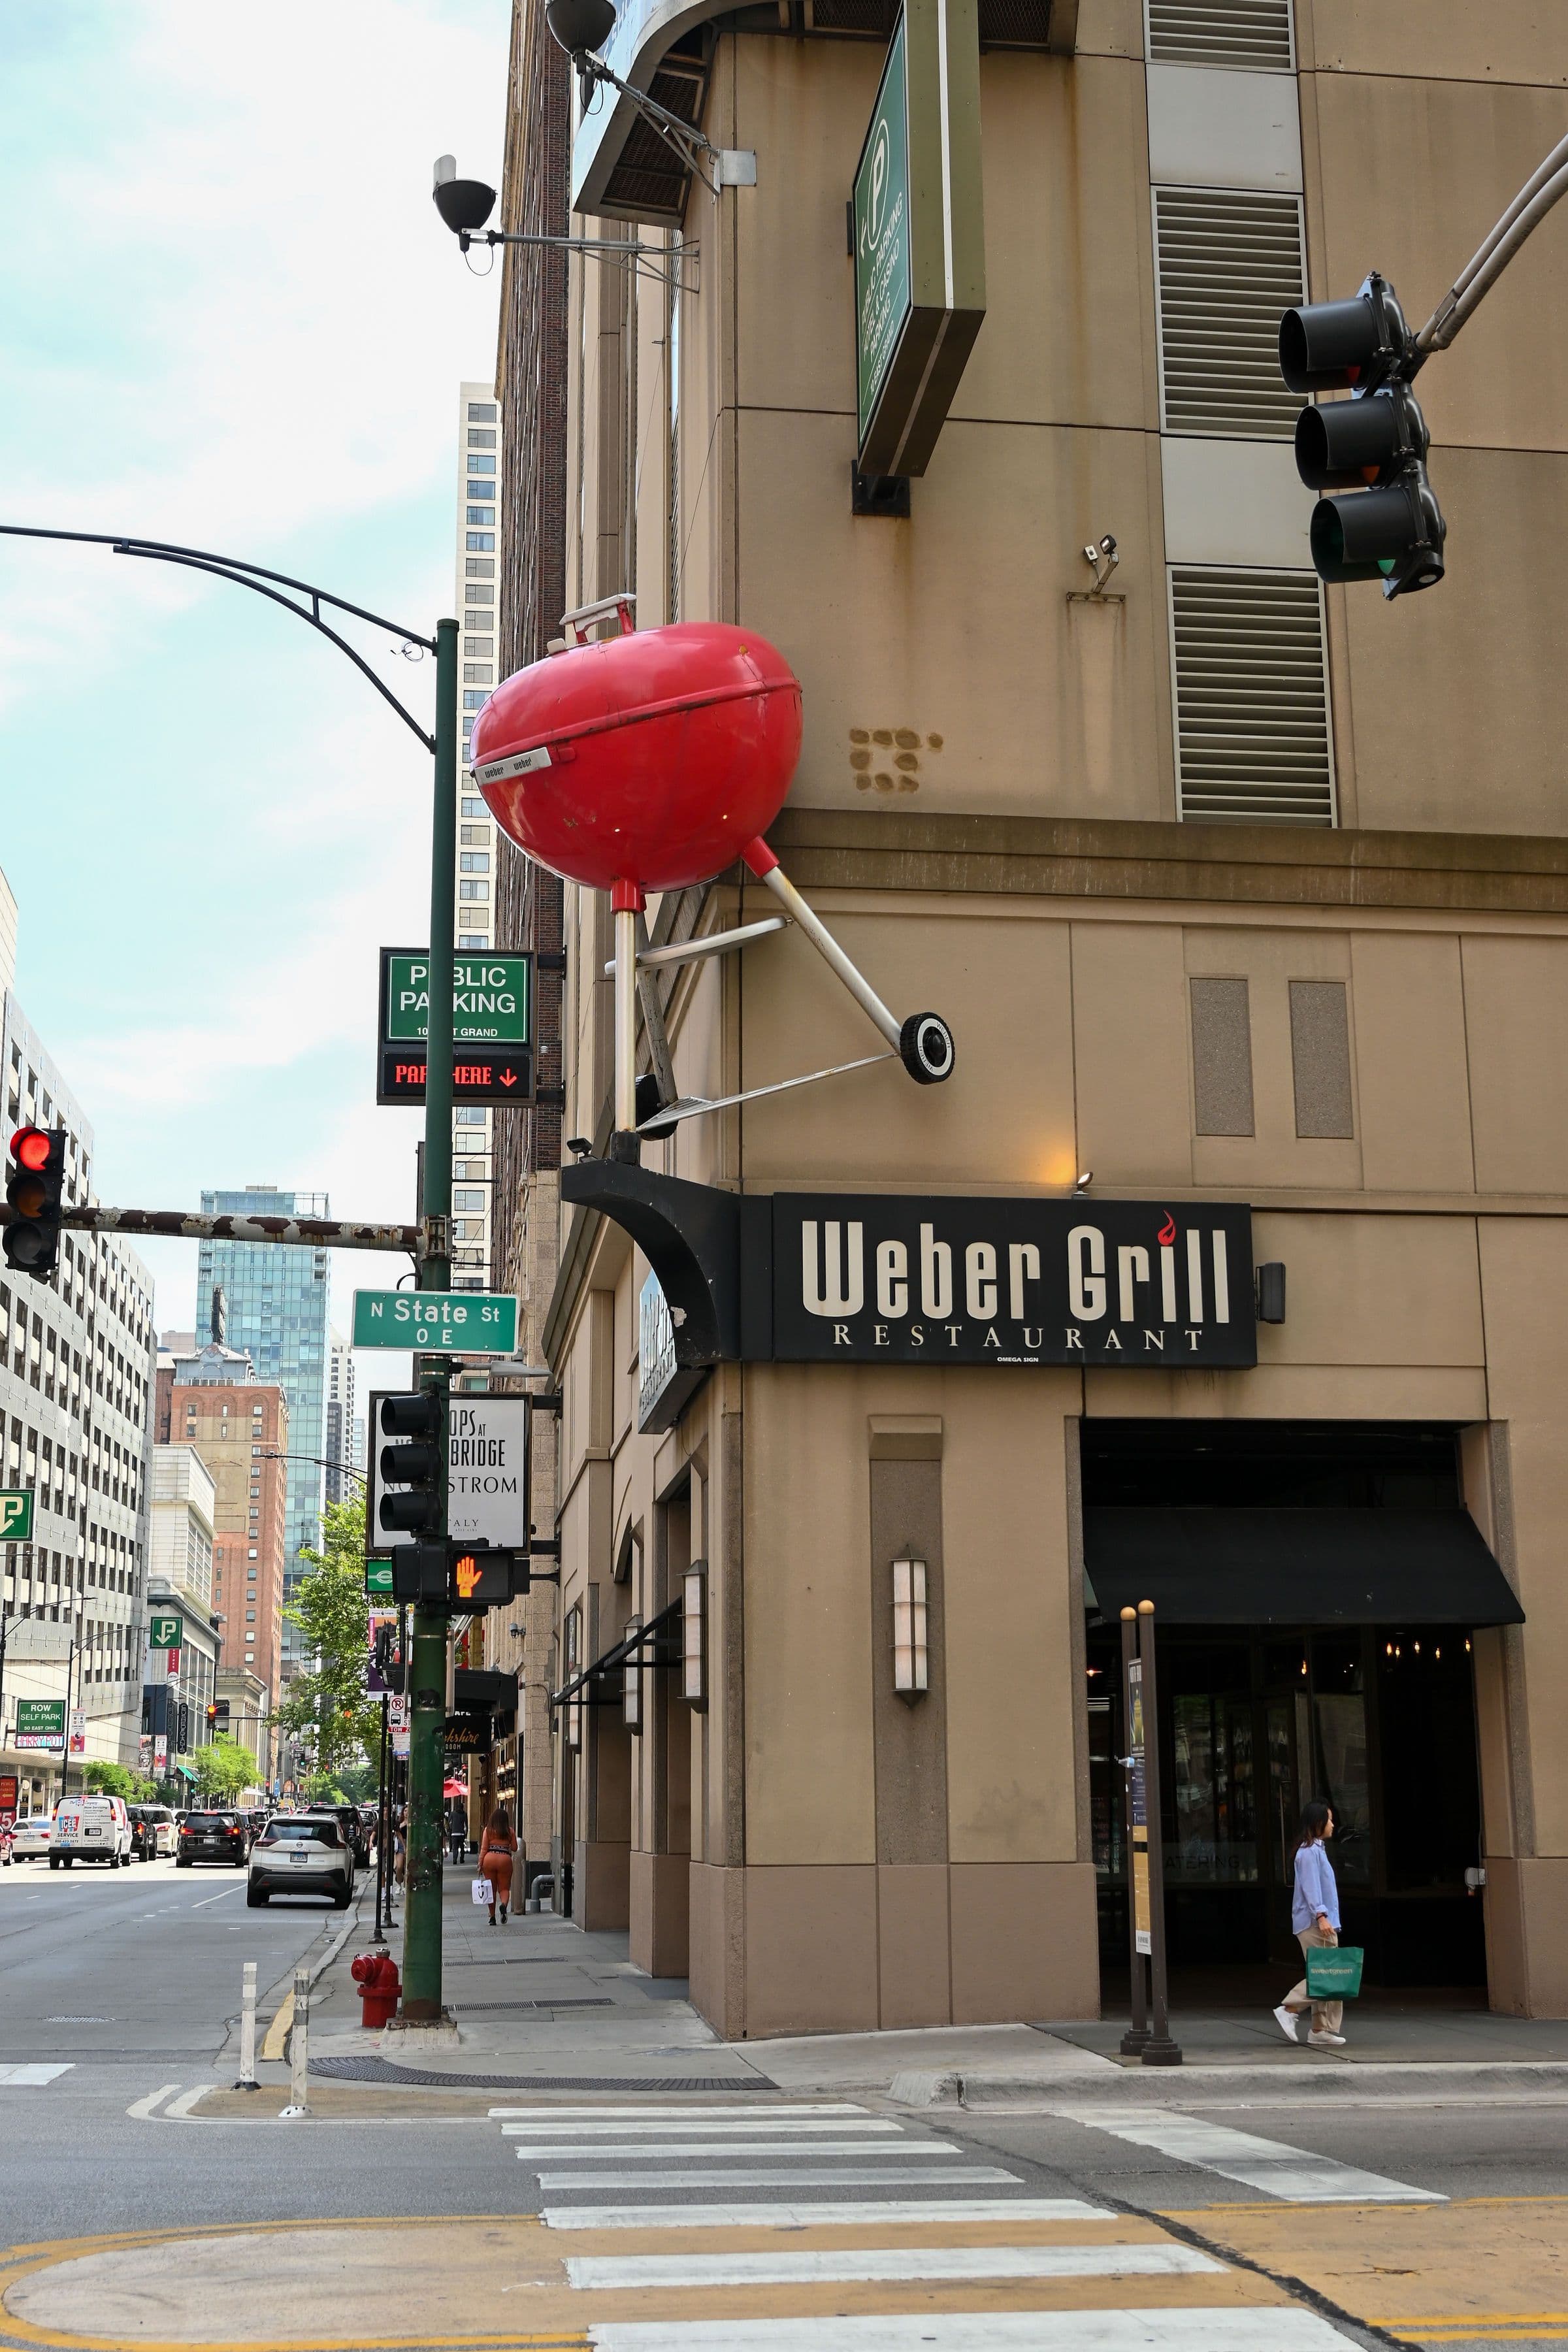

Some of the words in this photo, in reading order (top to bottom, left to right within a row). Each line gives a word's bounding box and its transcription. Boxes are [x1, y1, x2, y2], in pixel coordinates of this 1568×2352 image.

[862, 267, 876, 335] PUBLIC
[876, 191, 903, 277] PARKING
[864, 312, 875, 361] HOTEL
[875, 295, 880, 315] &
[879, 238, 900, 302] CASINO
[870, 291, 890, 363] PARKING
[874, 356, 883, 387] EAST
[883, 320, 894, 361] GRAND
[485, 766, 504, 778] weber
[514, 757, 532, 770] weber
[410, 966, 506, 987] PBLIC
[400, 992, 515, 1013] PAKING
[461, 1028, 498, 1037] GRAND
[802, 1220, 1040, 1320] Weber
[1068, 1210, 1229, 1323] Grill
[371, 1302, 383, 1317] N
[394, 1299, 468, 1324] State
[481, 1307, 500, 1322] St
[442, 1329, 453, 1345] E
[833, 1324, 1203, 1351] RESTAURANT
[478, 1424, 486, 1436] AT
[61, 1818, 76, 1829] ICEE
[1166, 1855, 1239, 1869] ATERING
